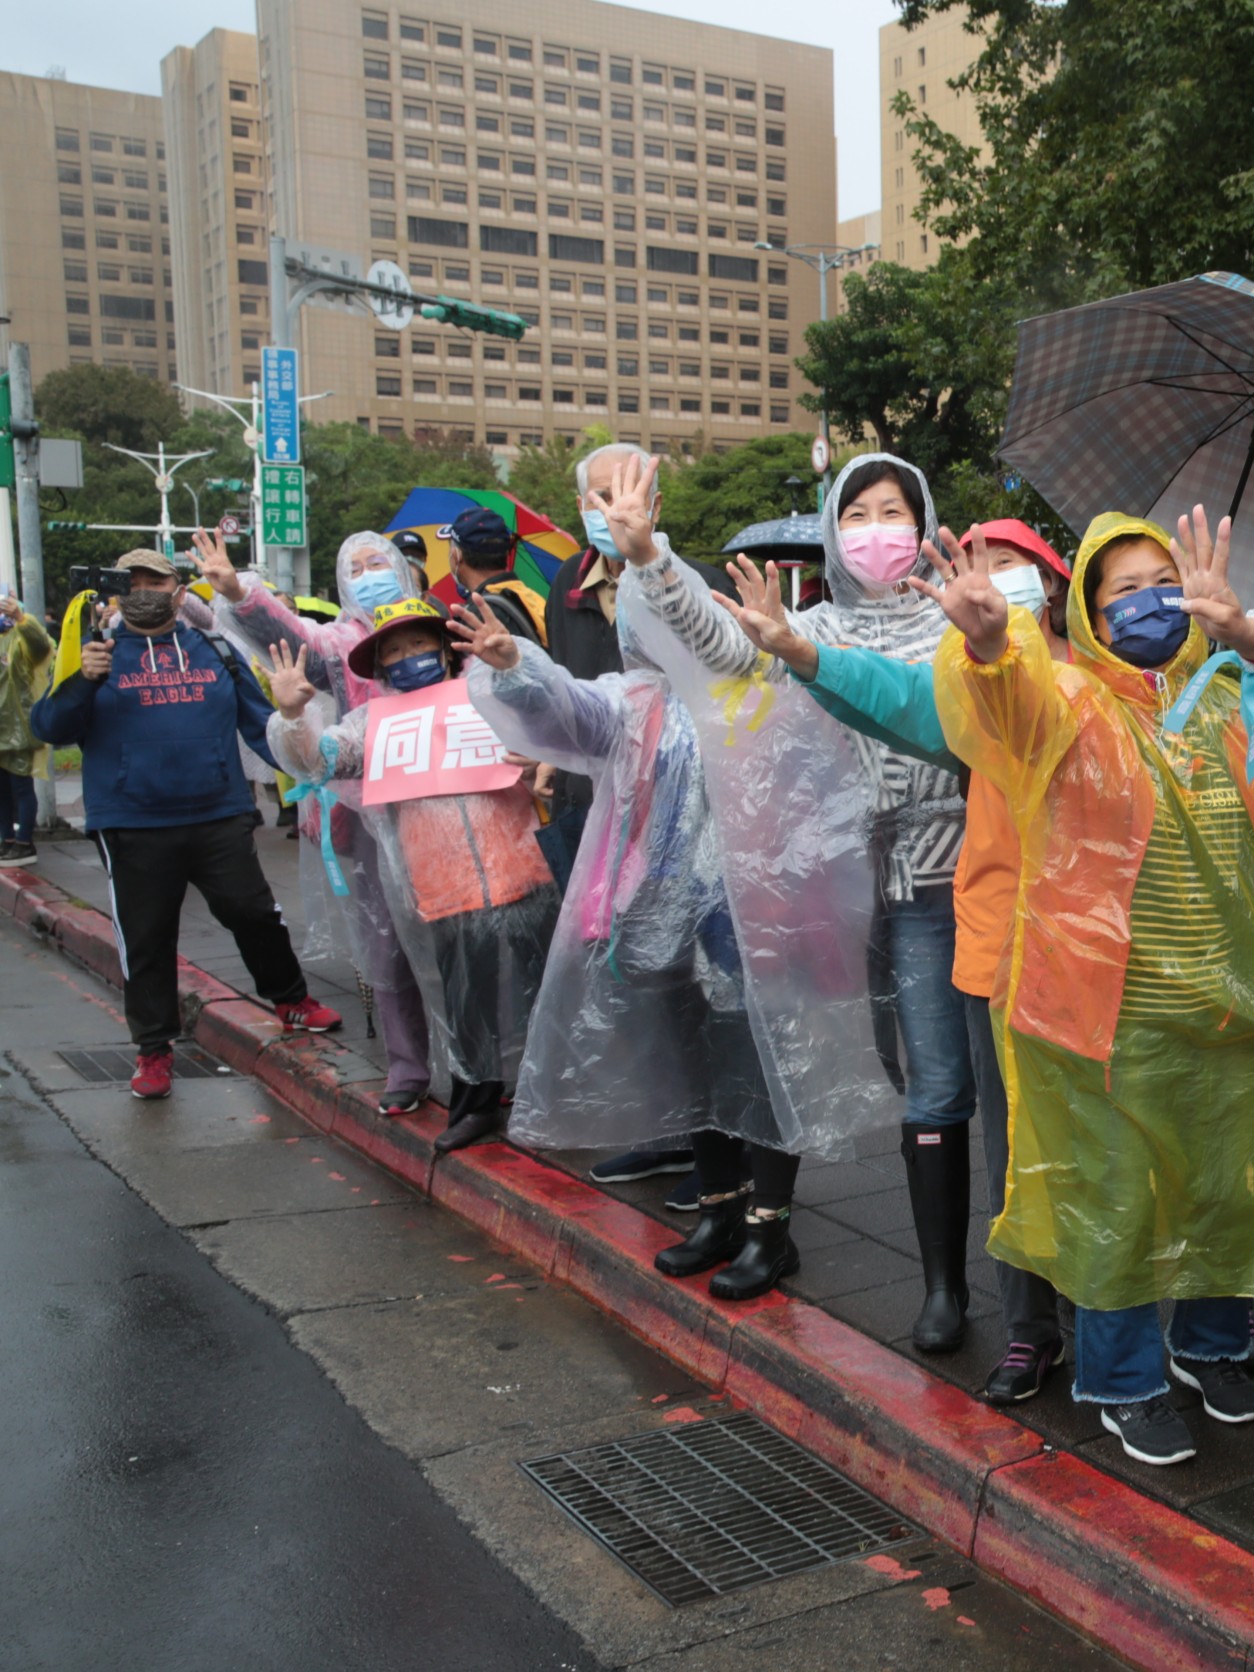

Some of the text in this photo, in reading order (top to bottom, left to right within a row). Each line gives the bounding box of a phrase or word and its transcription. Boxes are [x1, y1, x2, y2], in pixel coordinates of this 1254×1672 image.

[265, 469, 281, 543] 禮讓行人
[285, 469, 301, 544] 右轉車請
[118, 668, 218, 689] AMERICAN
[139, 685, 206, 706] EAGLE
[368, 703, 508, 782] 同意
